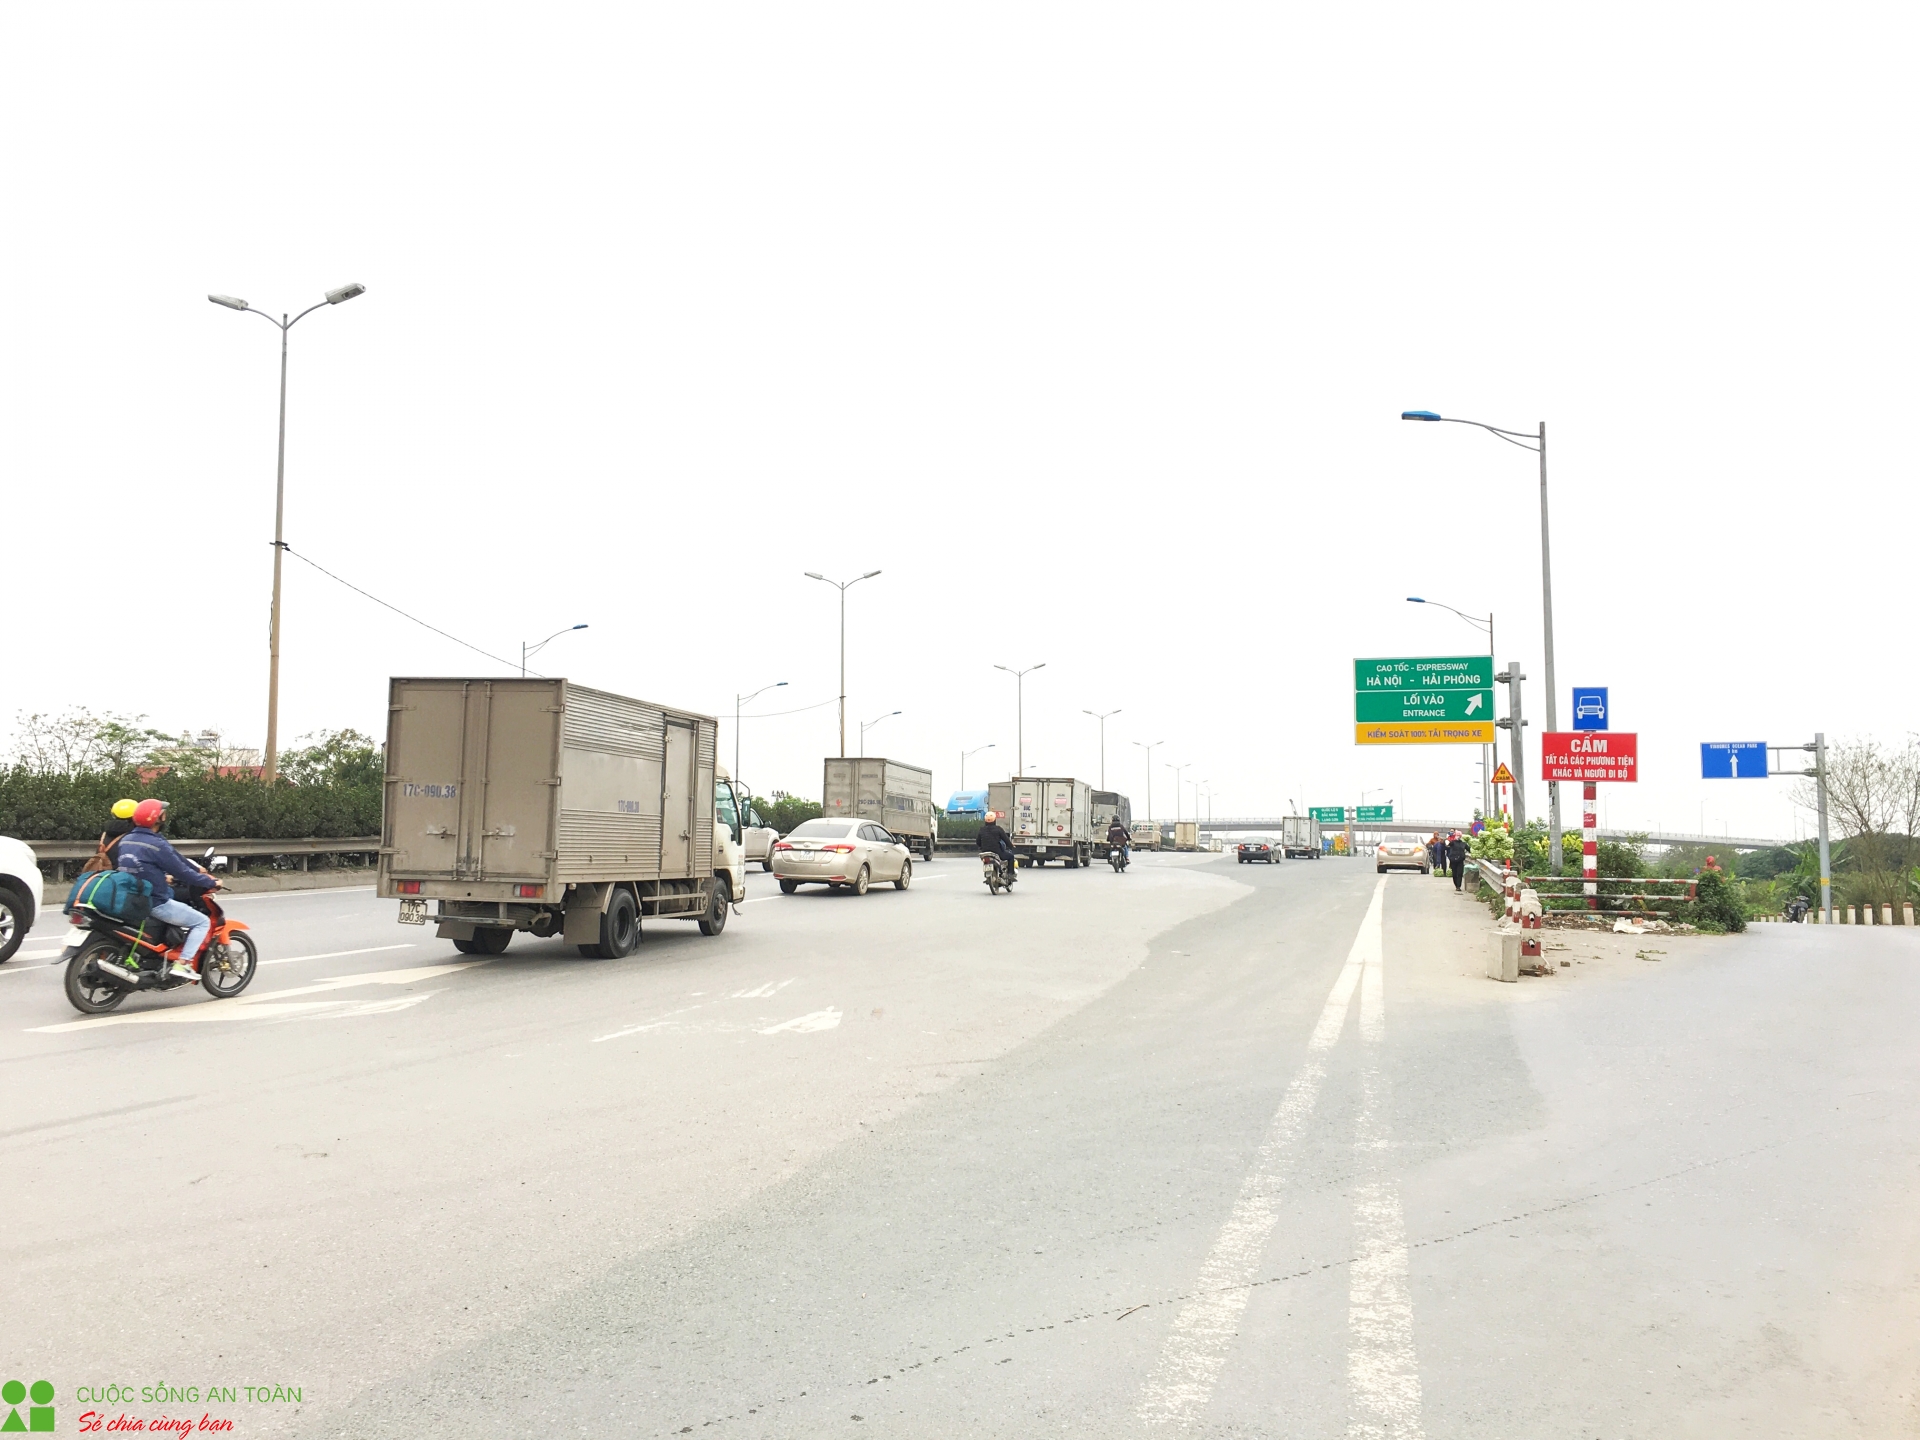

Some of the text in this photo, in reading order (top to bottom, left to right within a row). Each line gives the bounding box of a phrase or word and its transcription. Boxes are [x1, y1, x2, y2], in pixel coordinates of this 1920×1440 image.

[1394, 662, 1409, 671] TỐC
[1416, 663, 1469, 671] EXPRESSWAY
[1366, 675, 1381, 686] HÀ
[1384, 674, 1402, 687] NỘI
[1422, 673, 1440, 685] HẢI
[1443, 674, 1481, 684] PHÒNG
[1403, 693, 1444, 705] LỐI VÀO
[1402, 709, 1446, 717] ENTRANCE
[1367, 727, 1386, 739] KIỂM
[1388, 729, 1409, 738] SOÁT
[1443, 730, 1470, 739] TRỌNG
[1570, 734, 1608, 753] CẤM
[1545, 752, 1634, 768] TẤT CẢ CÁC PHƯƠNG TIỆN
[1552, 766, 1628, 781] KHÁC VÀ NGƯỜI ĐI BỘ
[403, 783, 457, 799] 17C-090.38
[407, 902, 421, 913] 17C
